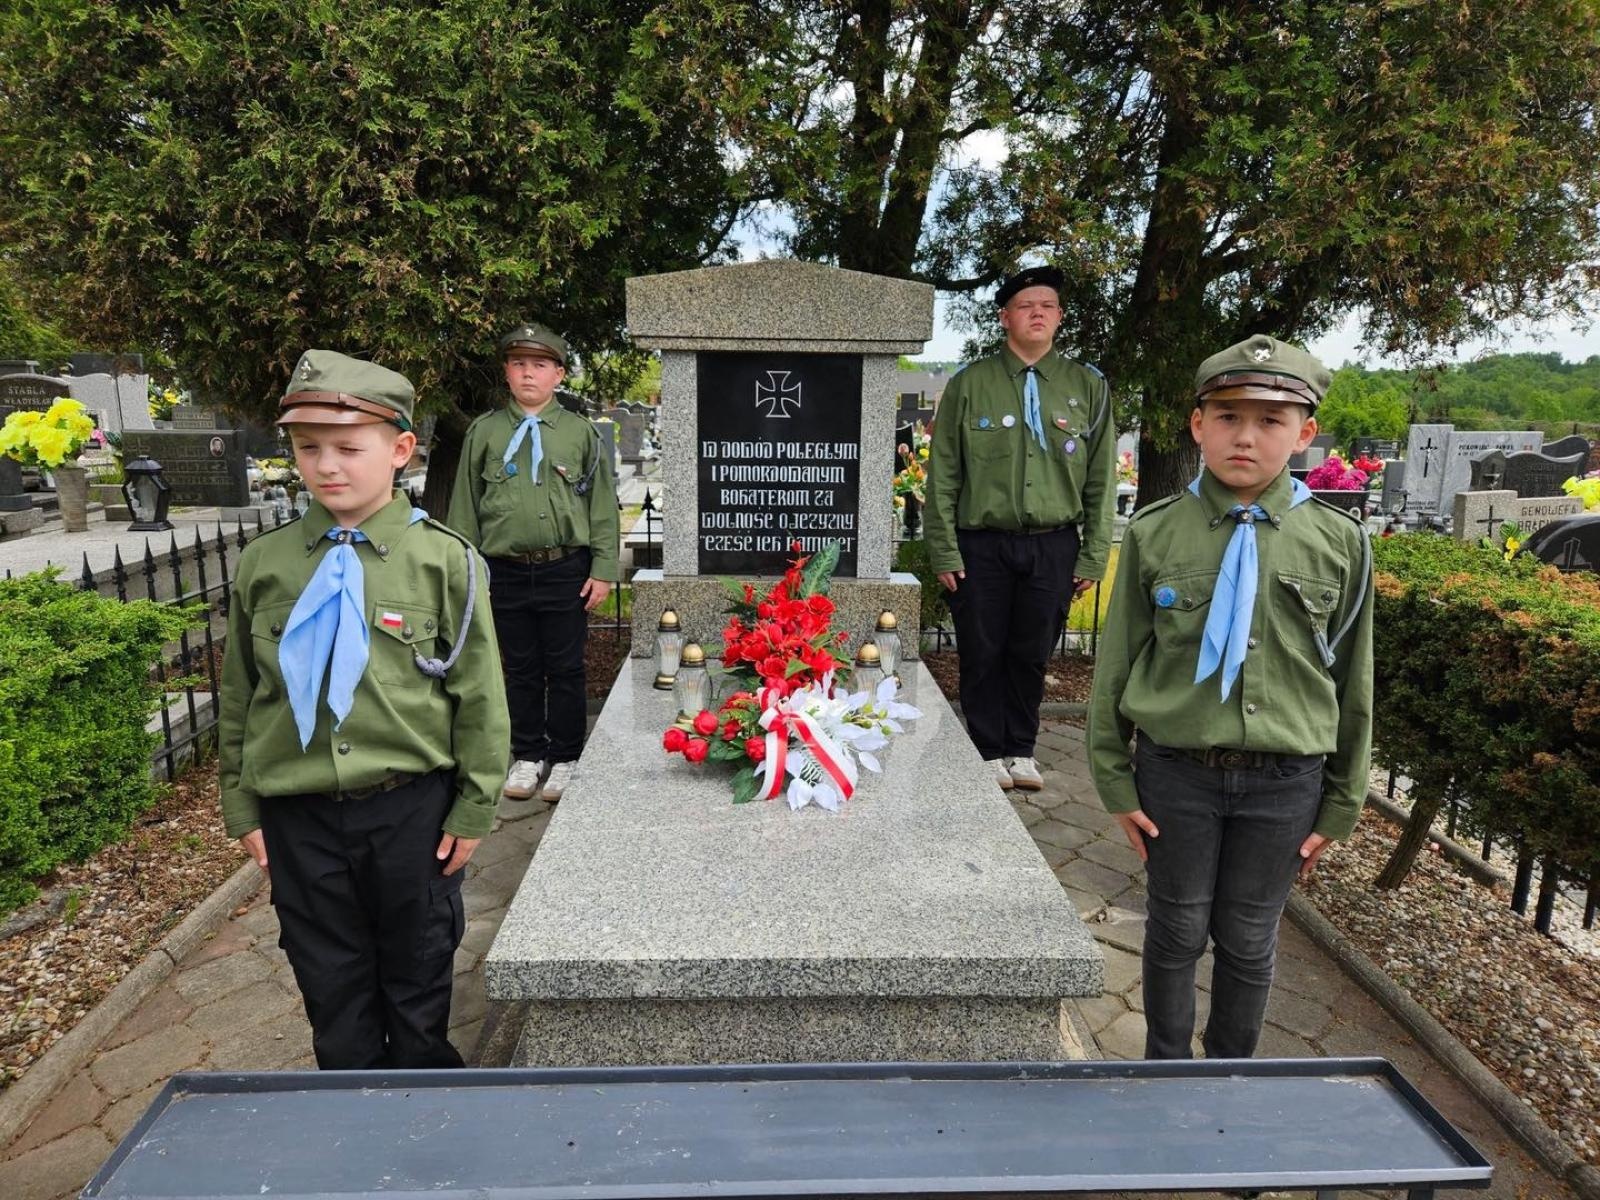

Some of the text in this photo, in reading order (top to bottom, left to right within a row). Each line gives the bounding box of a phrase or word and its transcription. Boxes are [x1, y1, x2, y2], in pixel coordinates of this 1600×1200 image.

[702, 436, 858, 460] W DOWÓD POLEGŁYM
[711, 465, 845, 483] I POMORDOWANYM
[721, 489, 834, 507] BOHATEROM ZA
[779, 513, 854, 530] OJCZYZNY
[757, 535, 781, 551] ICH
